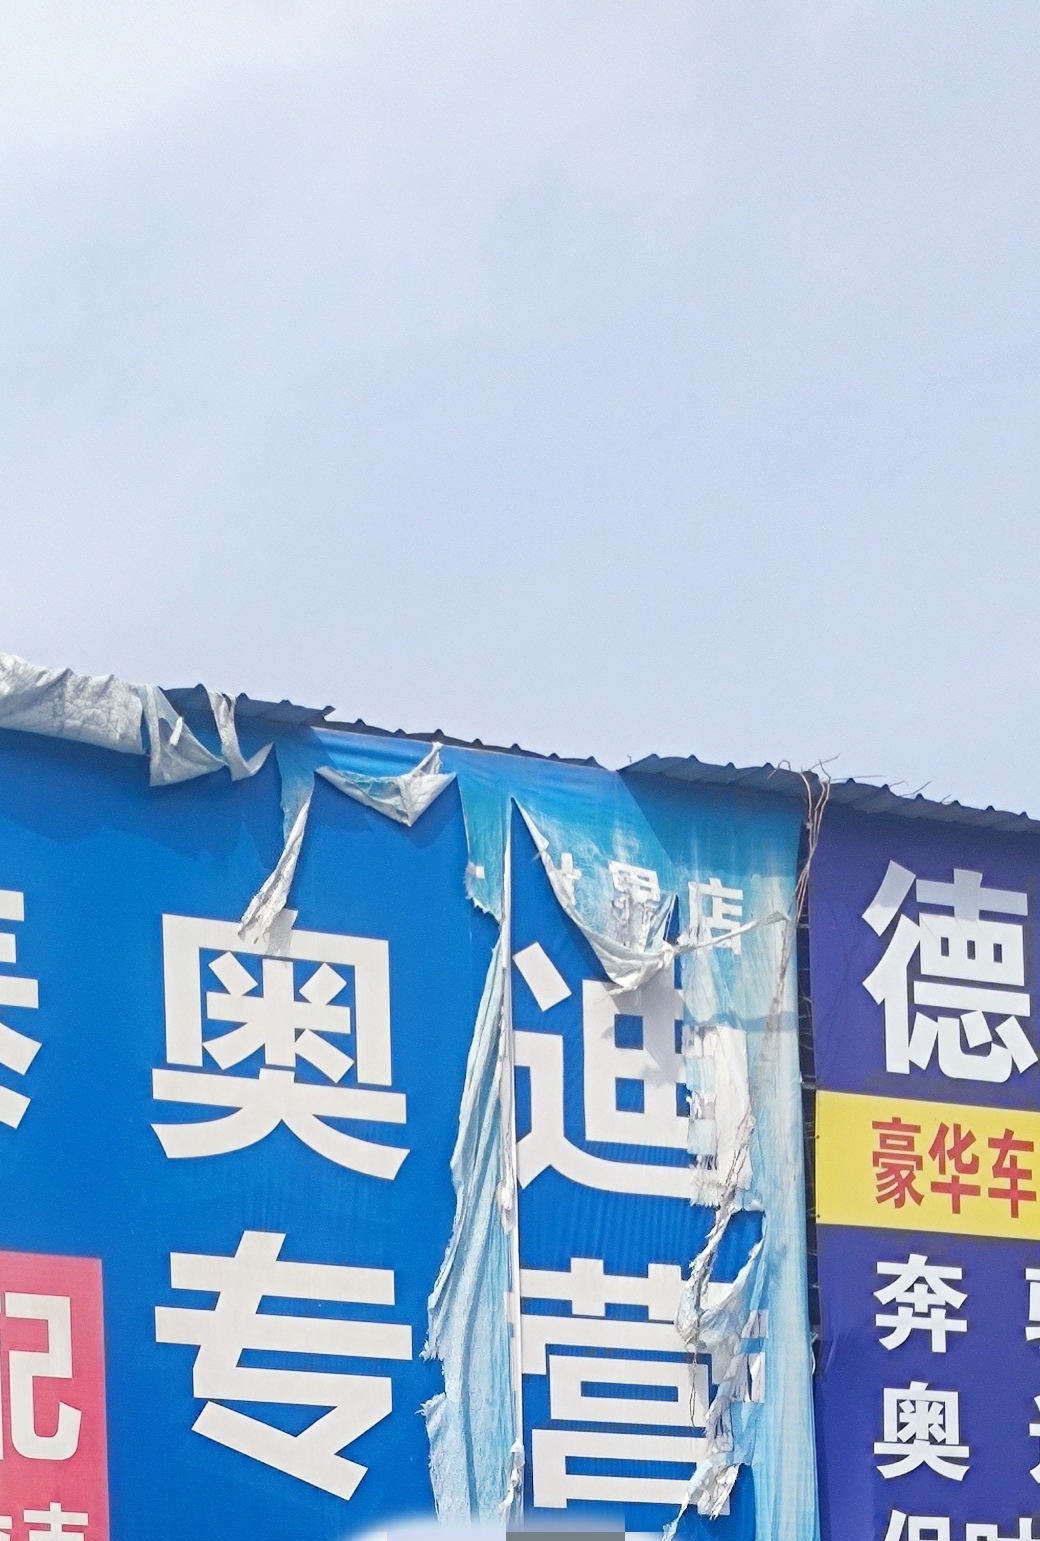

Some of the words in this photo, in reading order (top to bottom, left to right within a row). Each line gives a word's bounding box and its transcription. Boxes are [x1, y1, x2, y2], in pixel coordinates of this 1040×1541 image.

[860, 860, 1040, 1083] 德
[871, 1116, 1040, 1218] 豪华车
